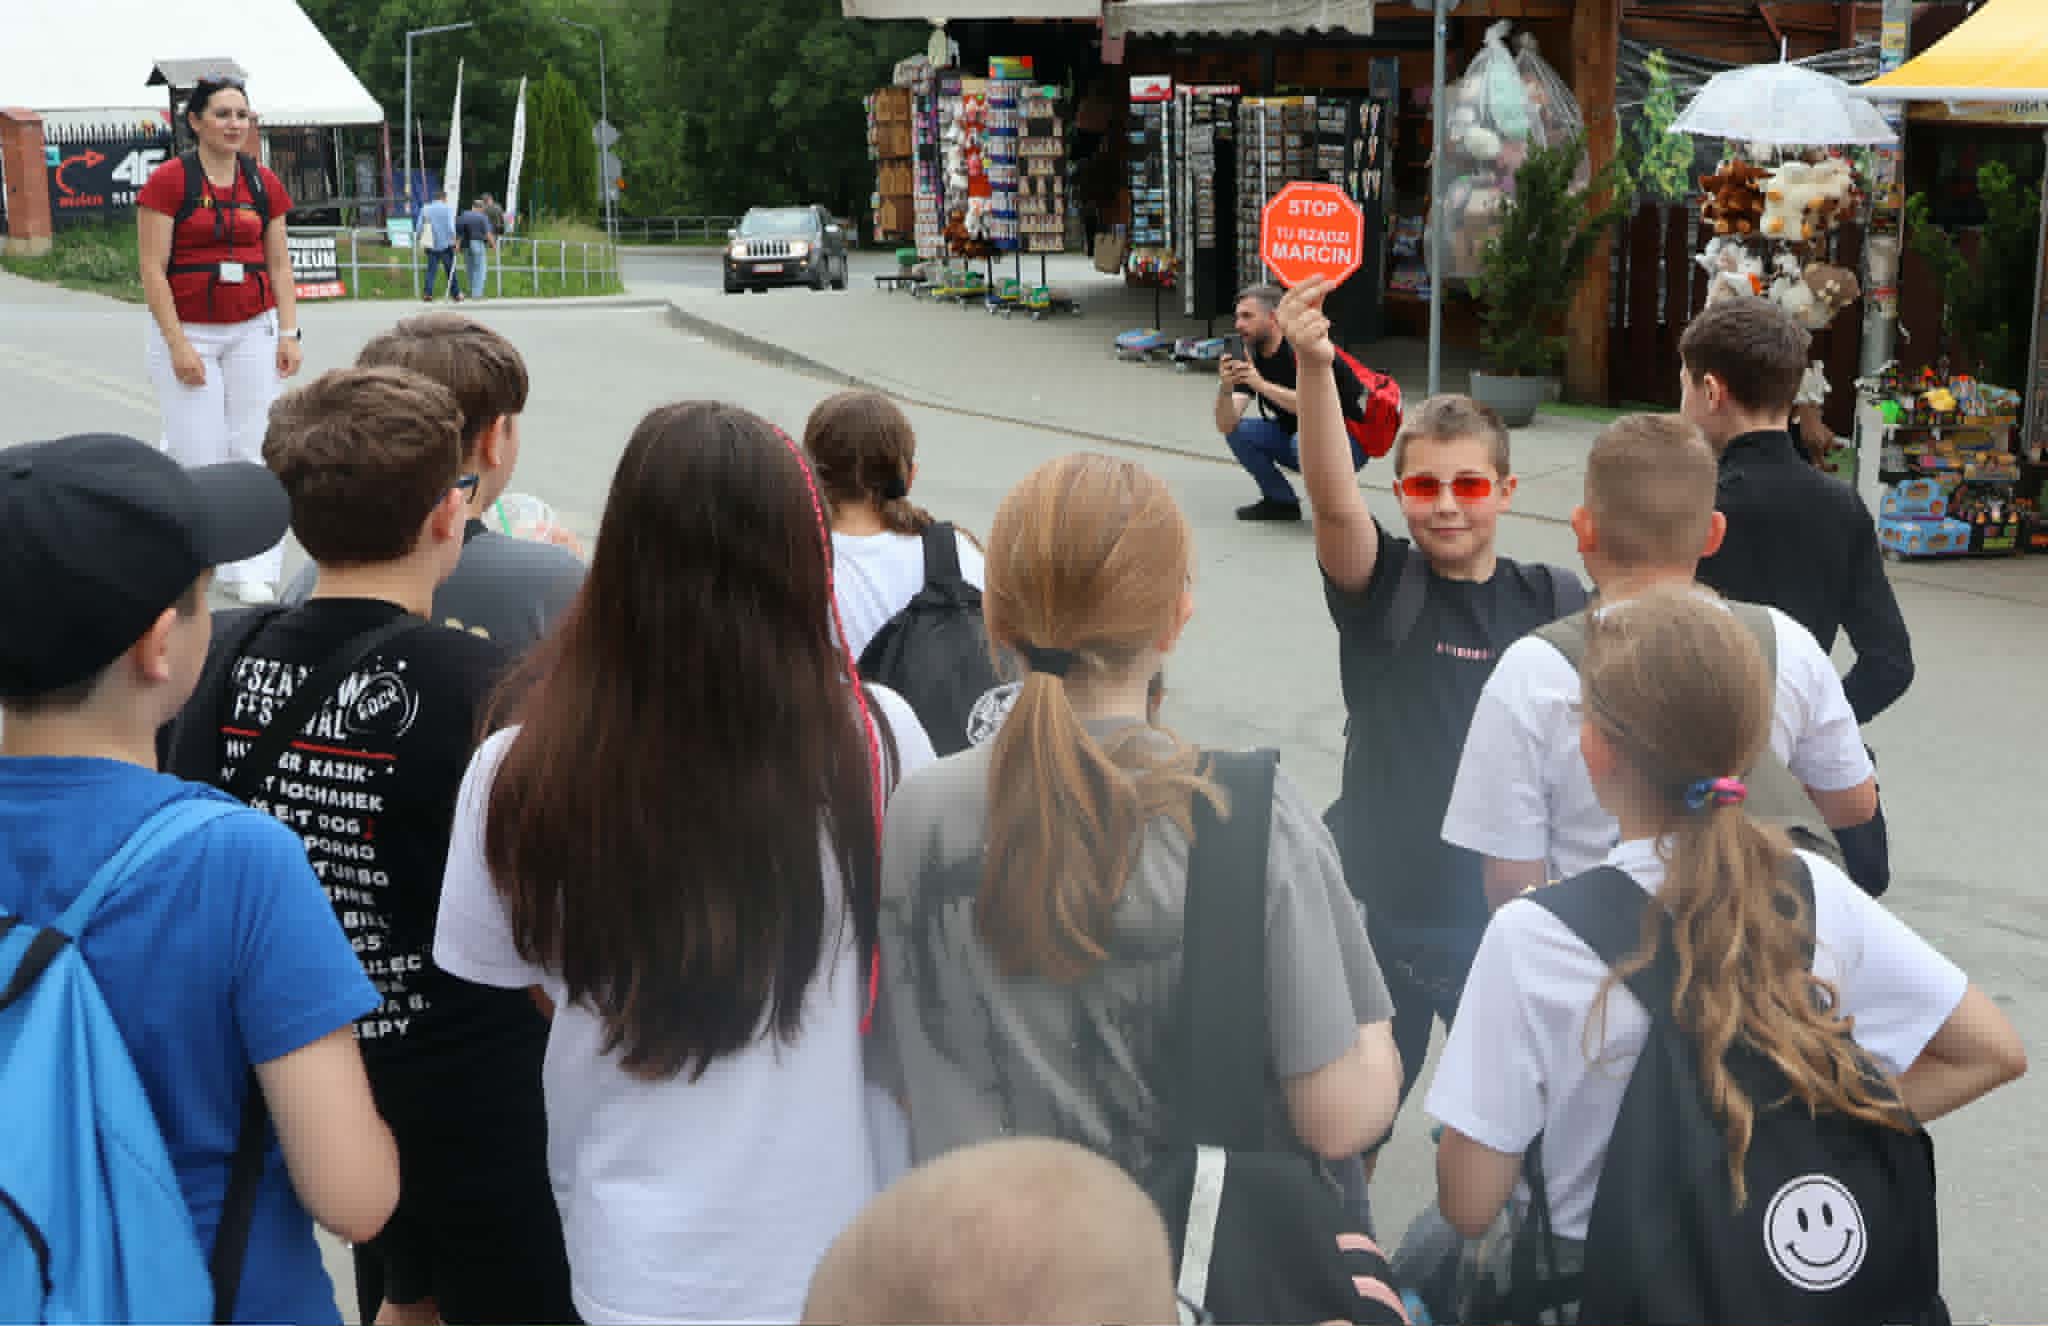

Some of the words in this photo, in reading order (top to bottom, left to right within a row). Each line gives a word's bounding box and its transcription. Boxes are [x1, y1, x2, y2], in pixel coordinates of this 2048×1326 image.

[1288, 199, 1340, 217] STOP
[1276, 225, 1294, 241] TU
[288, 250, 336, 268] ZEUM
[1272, 242, 1351, 264] MARCIN
[309, 757, 367, 782] KAZIK
[303, 834, 376, 861] PORNO
[311, 860, 389, 887] TURBO
